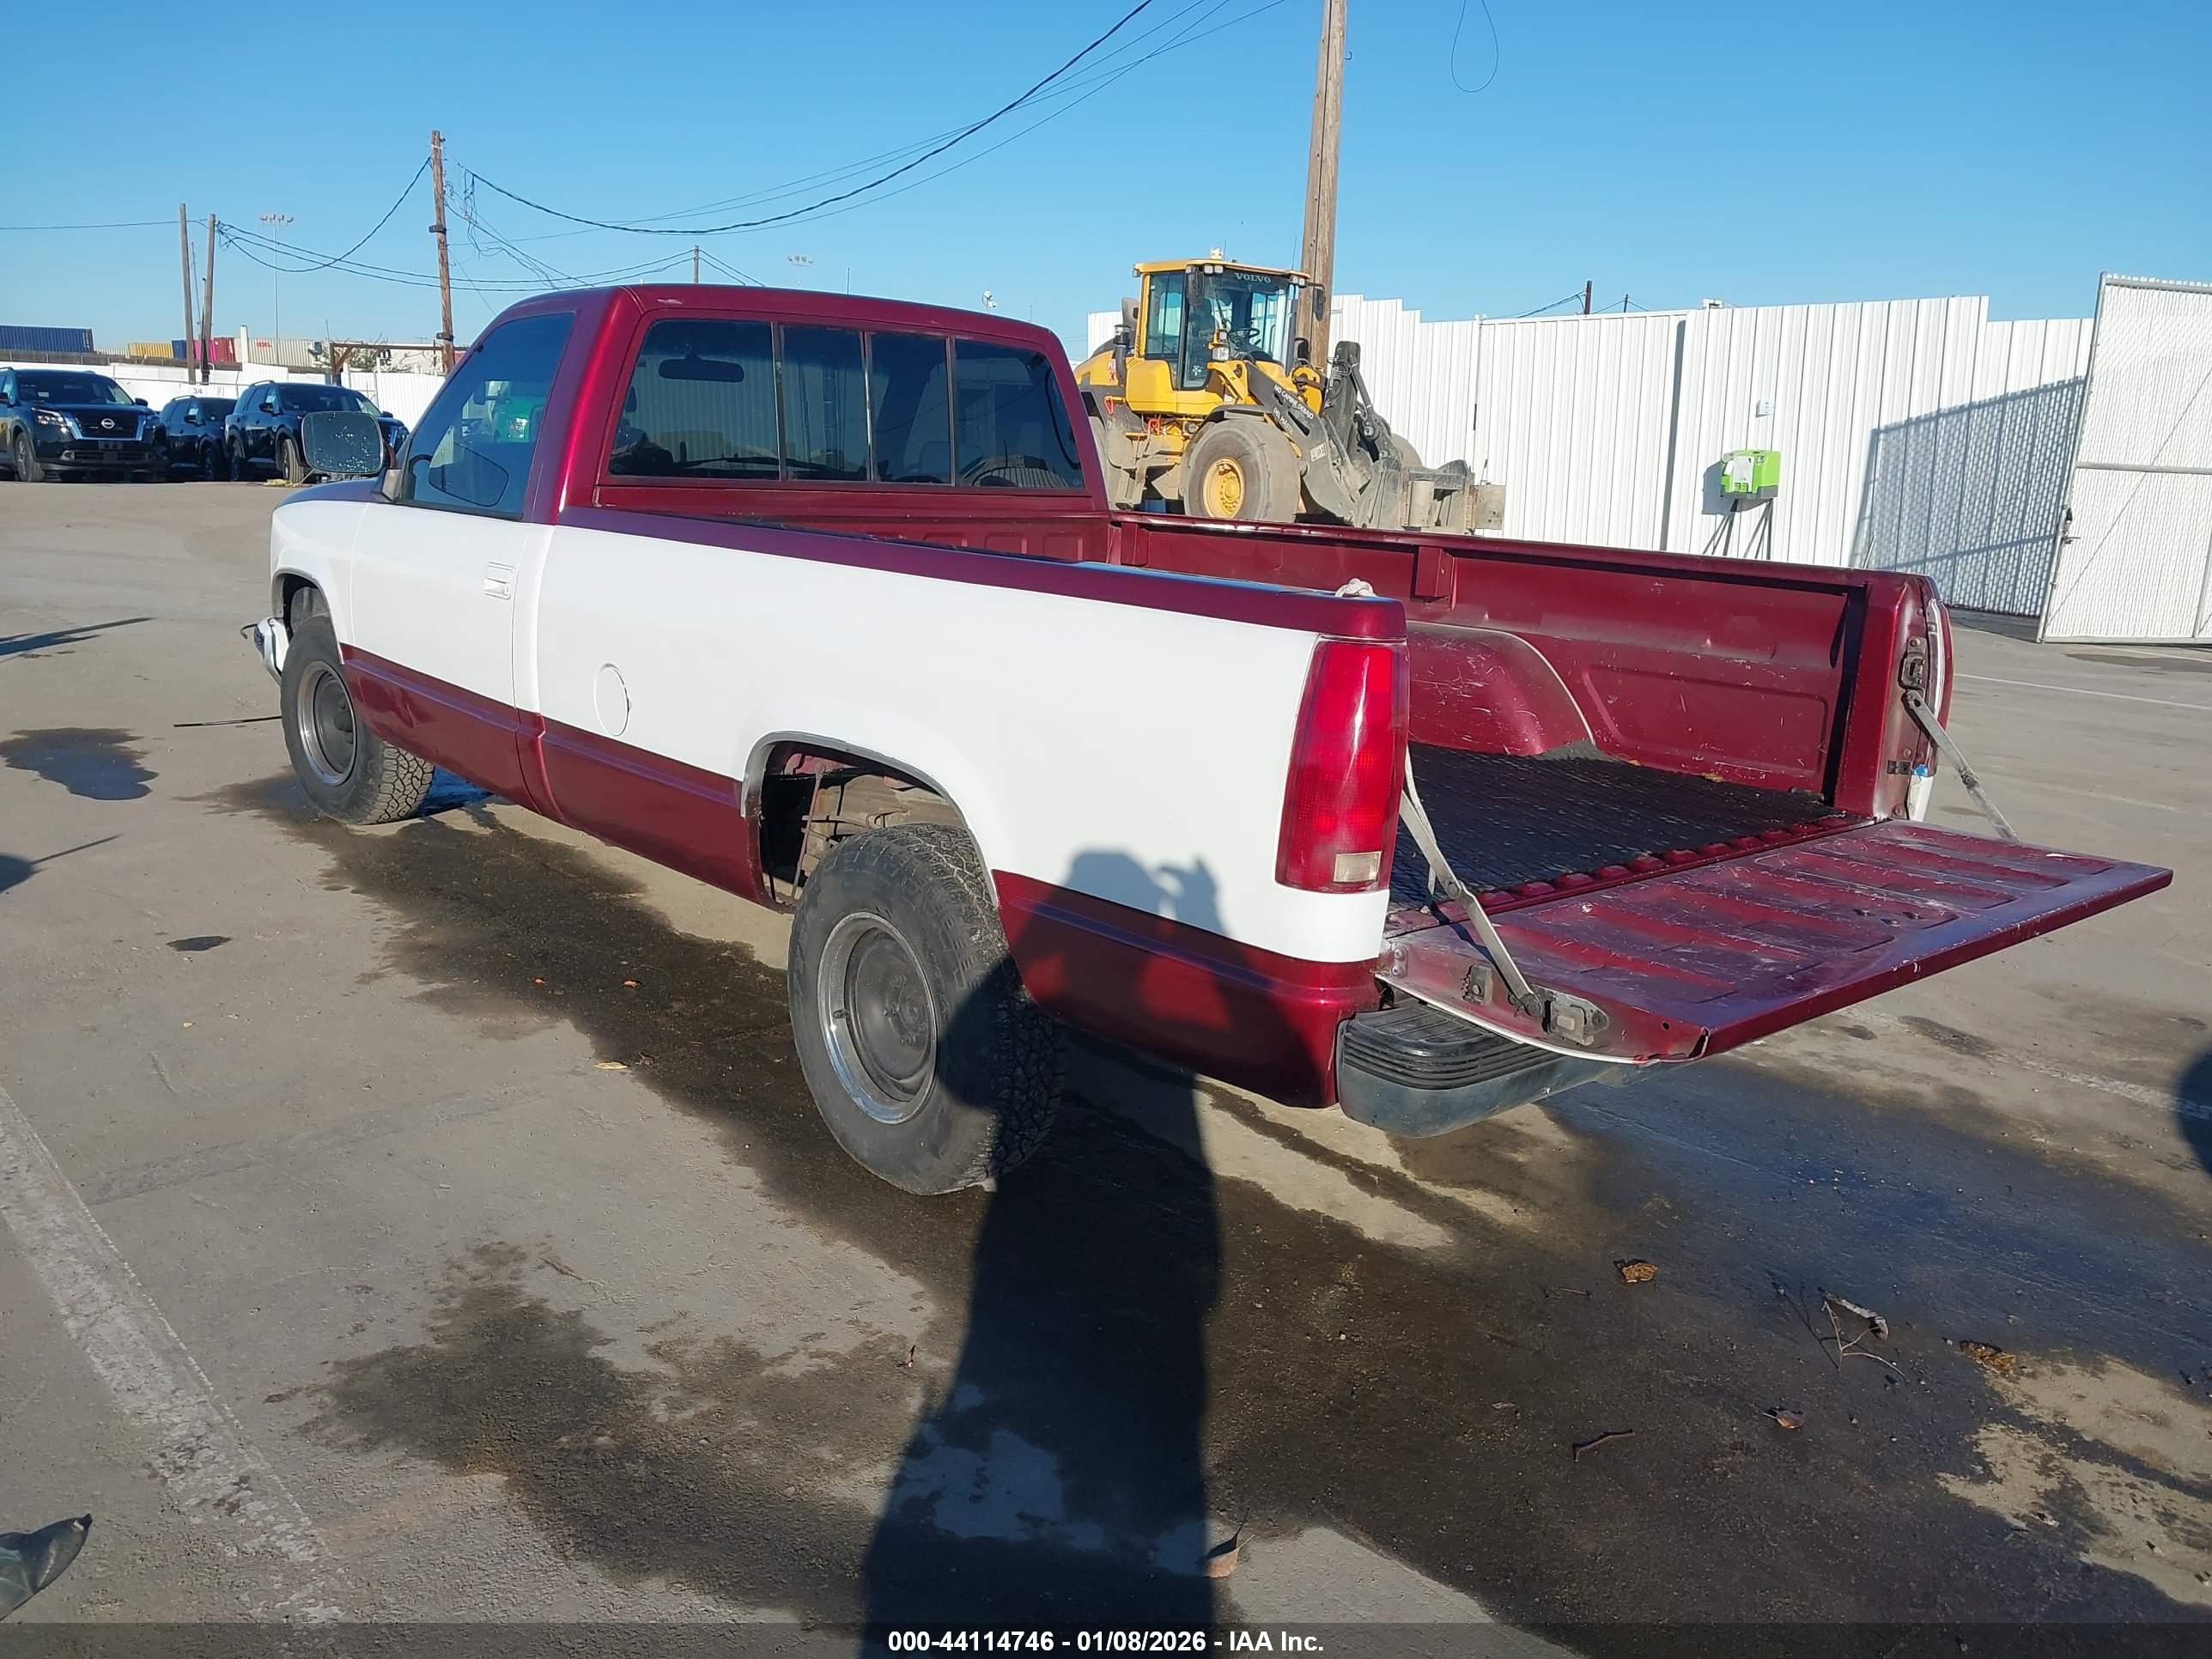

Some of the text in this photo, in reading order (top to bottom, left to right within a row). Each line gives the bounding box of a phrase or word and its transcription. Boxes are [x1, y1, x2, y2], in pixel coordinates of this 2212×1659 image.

[1235, 272, 1271, 283] VOLVO
[1273, 385, 1315, 419] NO CAMINE DEBAJO
